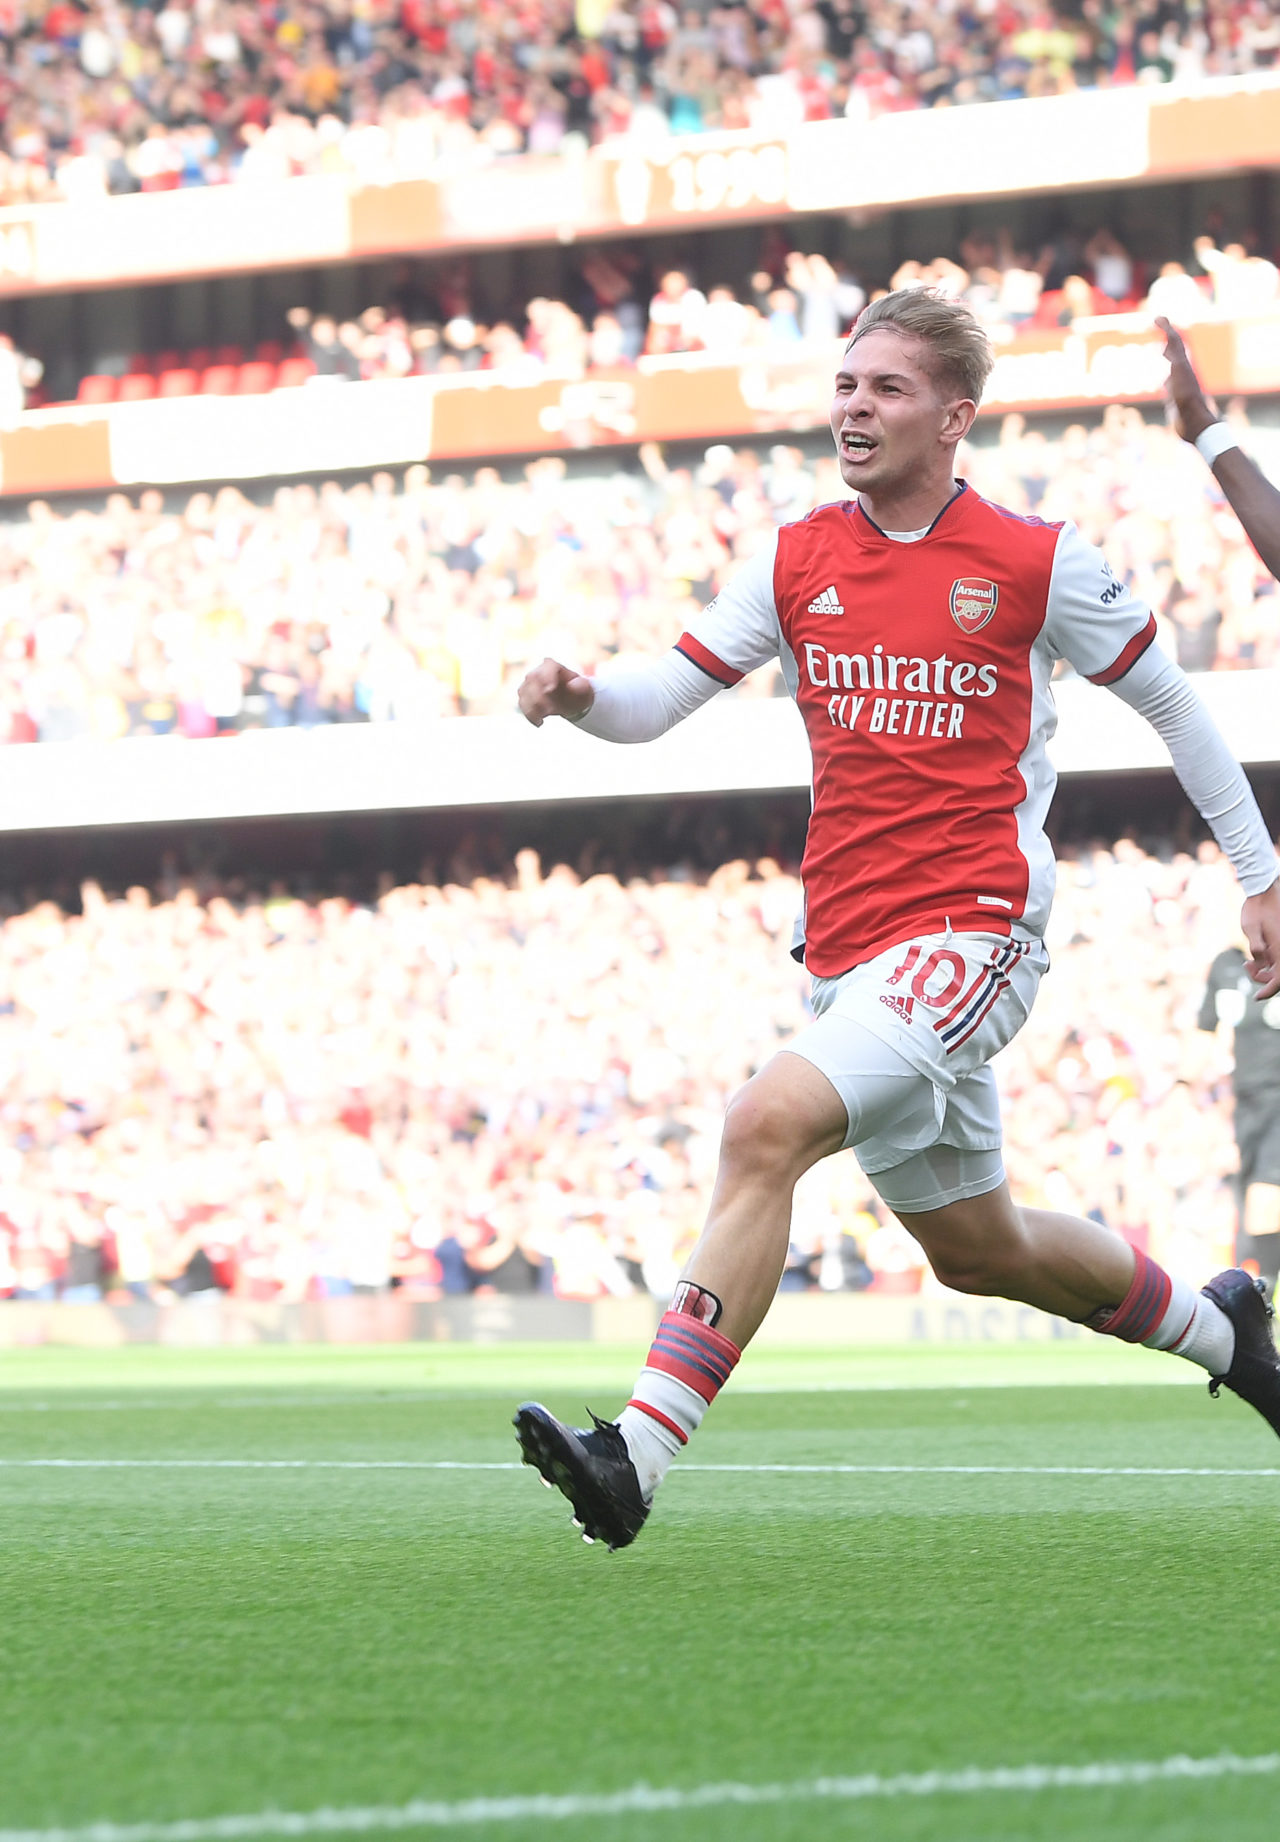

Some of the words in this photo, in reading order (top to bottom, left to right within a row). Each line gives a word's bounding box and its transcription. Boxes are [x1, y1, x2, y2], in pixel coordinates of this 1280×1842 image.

[808, 604, 844, 615] adidas
[957, 586, 993, 598] Arsenal
[804, 643, 998, 697] Emirates
[828, 695, 865, 730] FLY
[869, 697, 965, 739] BETTER
[885, 945, 966, 1008] 10
[880, 995, 913, 1025] adidas
